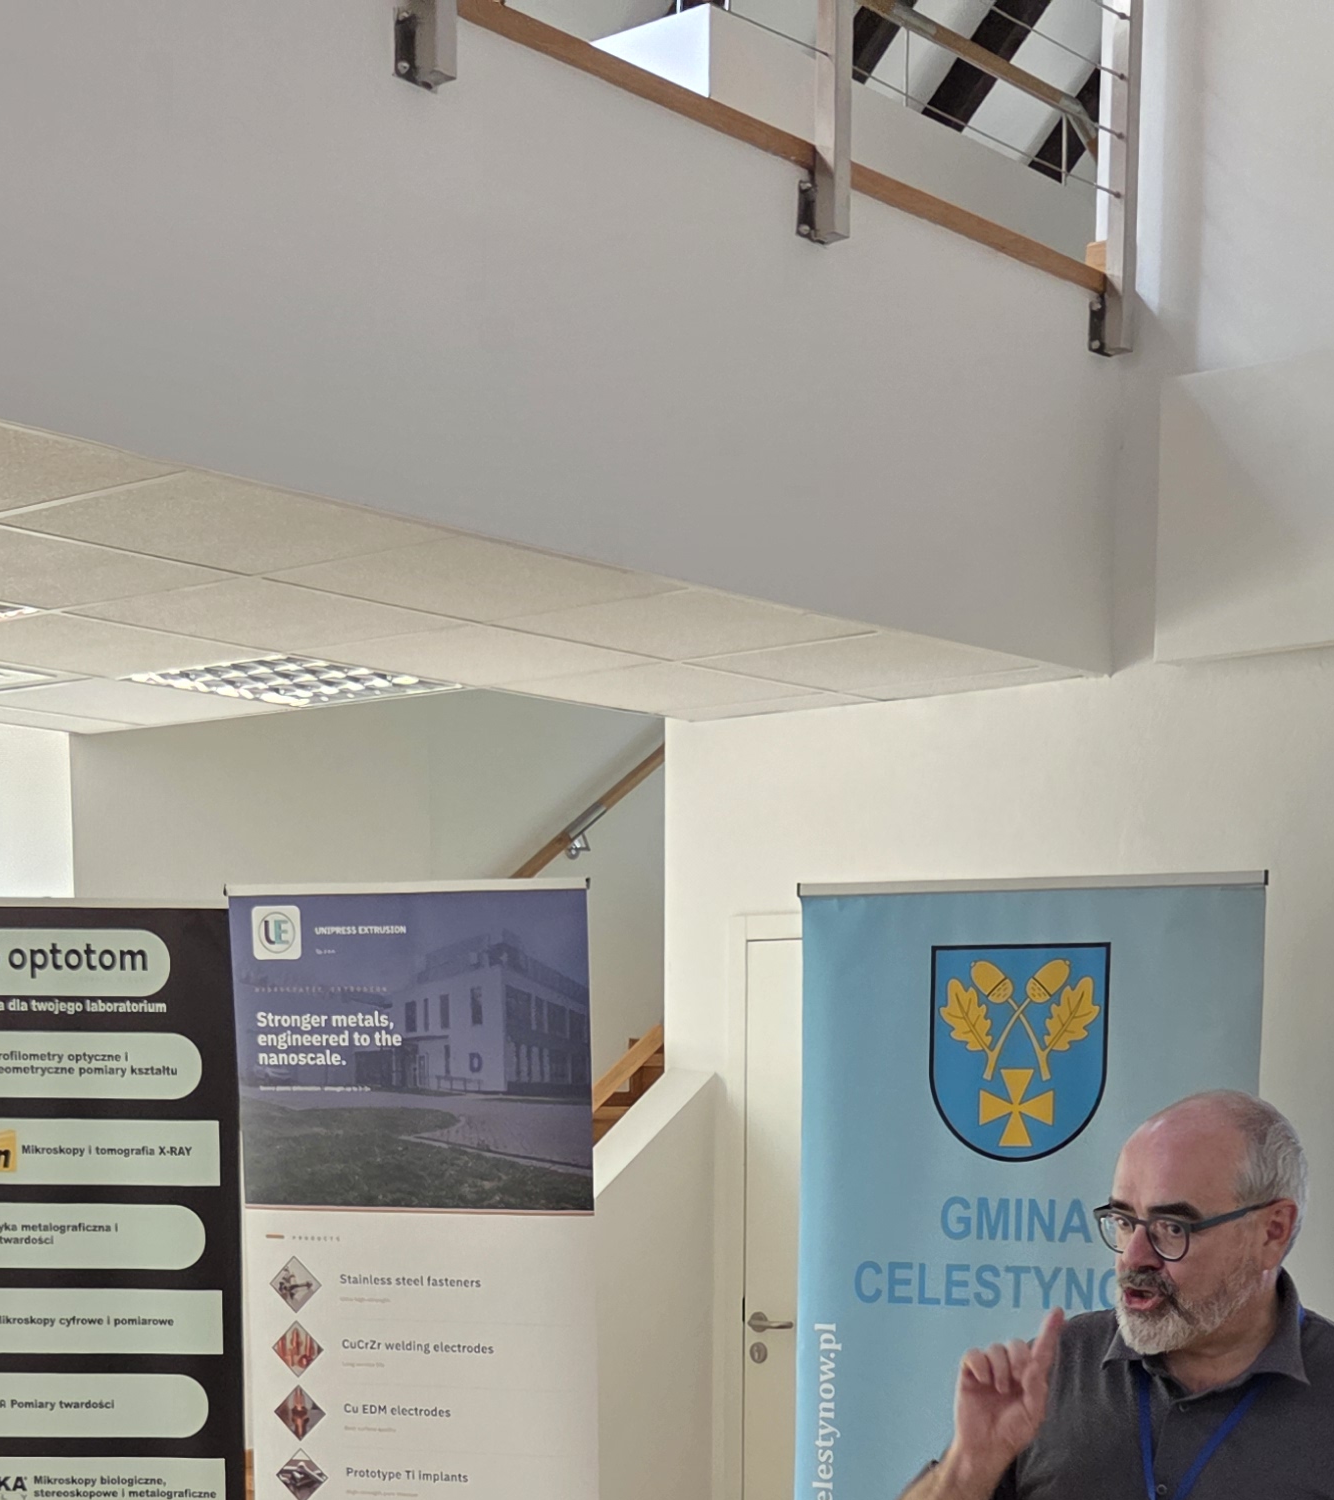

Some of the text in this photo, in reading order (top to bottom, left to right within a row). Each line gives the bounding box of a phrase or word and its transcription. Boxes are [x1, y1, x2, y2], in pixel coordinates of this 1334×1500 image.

[315, 925, 407, 936] UNIPRESS EXTRUSION
[8, 942, 149, 979] optotom
[8, 998, 28, 1012] dla
[31, 1000, 83, 1015] twojego
[86, 999, 167, 1013] laboratorium
[257, 1010, 394, 1031] Stronger metals,
[257, 1030, 402, 1050] engineered to the
[67, 1052, 121, 1064] optyczne
[258, 1050, 347, 1066] nanoscale.
[79, 1065, 127, 1078] pomiary
[130, 1065, 178, 1076] kształtu
[21, 1144, 86, 1157] Mikroskopy
[95, 1146, 155, 1158] tomografia
[158, 1146, 193, 1157] X-RAY
[940, 1195, 1093, 1244] GMINA
[21, 1222, 112, 1235] metalograficzna
[339, 1273, 482, 1289] Stainless steel fasteners
[59, 1315, 104, 1328] cyfrowe
[114, 1316, 175, 1328] pomiarowe
[341, 1338, 495, 1355] CuCrZr welding electrodes
[10, 1399, 57, 1411] Pomiary
[59, 1398, 115, 1410] twardości
[343, 1403, 451, 1418] Cu EDM electrodes
[33, 1475, 167, 1488] Mikroskopy biologiczne,
[346, 1467, 469, 1484] Prototype Ti implants
[33, 1488, 118, 1500] stereoskopowe
[128, 1488, 217, 1500] metalograficzne
